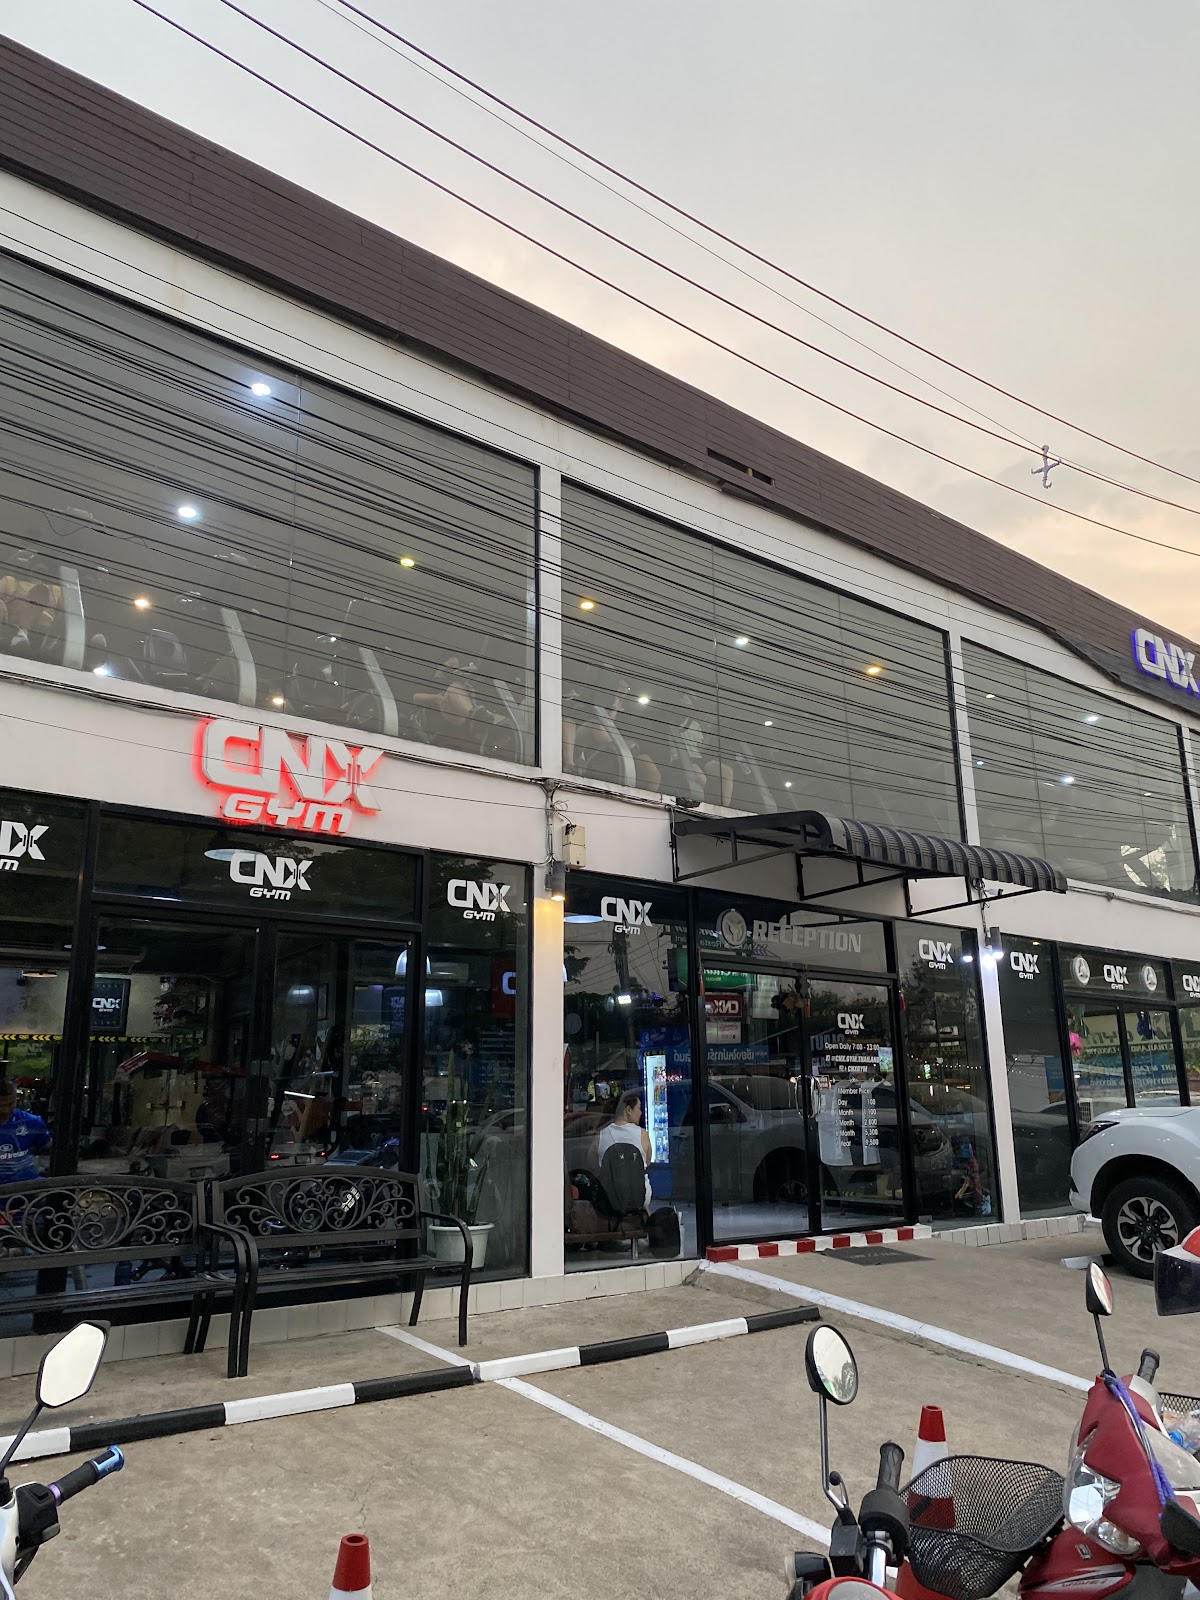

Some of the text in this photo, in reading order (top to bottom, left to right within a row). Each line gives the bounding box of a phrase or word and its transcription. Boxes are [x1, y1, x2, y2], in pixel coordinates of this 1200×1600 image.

[1134, 628, 1200, 693] CNX
[202, 718, 386, 811] CNX
[222, 793, 353, 834] GYM
[229, 851, 313, 891] CNX
[249, 887, 292, 901] GYM
[447, 878, 511, 913] CNX
[463, 909, 496, 921] GYM
[601, 896, 653, 927] CNX
[614, 924, 641, 935] GYM
[752, 919, 862, 953] RECEPTION
[918, 939, 954, 963] CNX
[928, 961, 946, 970] GYM
[1010, 951, 1040, 973] CNX
[1018, 971, 1034, 980] GYM
[1103, 964, 1130, 985] CNX
[92, 997, 121, 1009] CNX
[837, 1012, 865, 1030] CNX
[824, 1042, 839, 1050] Open
[839, 1042, 852, 1051] Daily
[837, 1098, 848, 1107] Day
